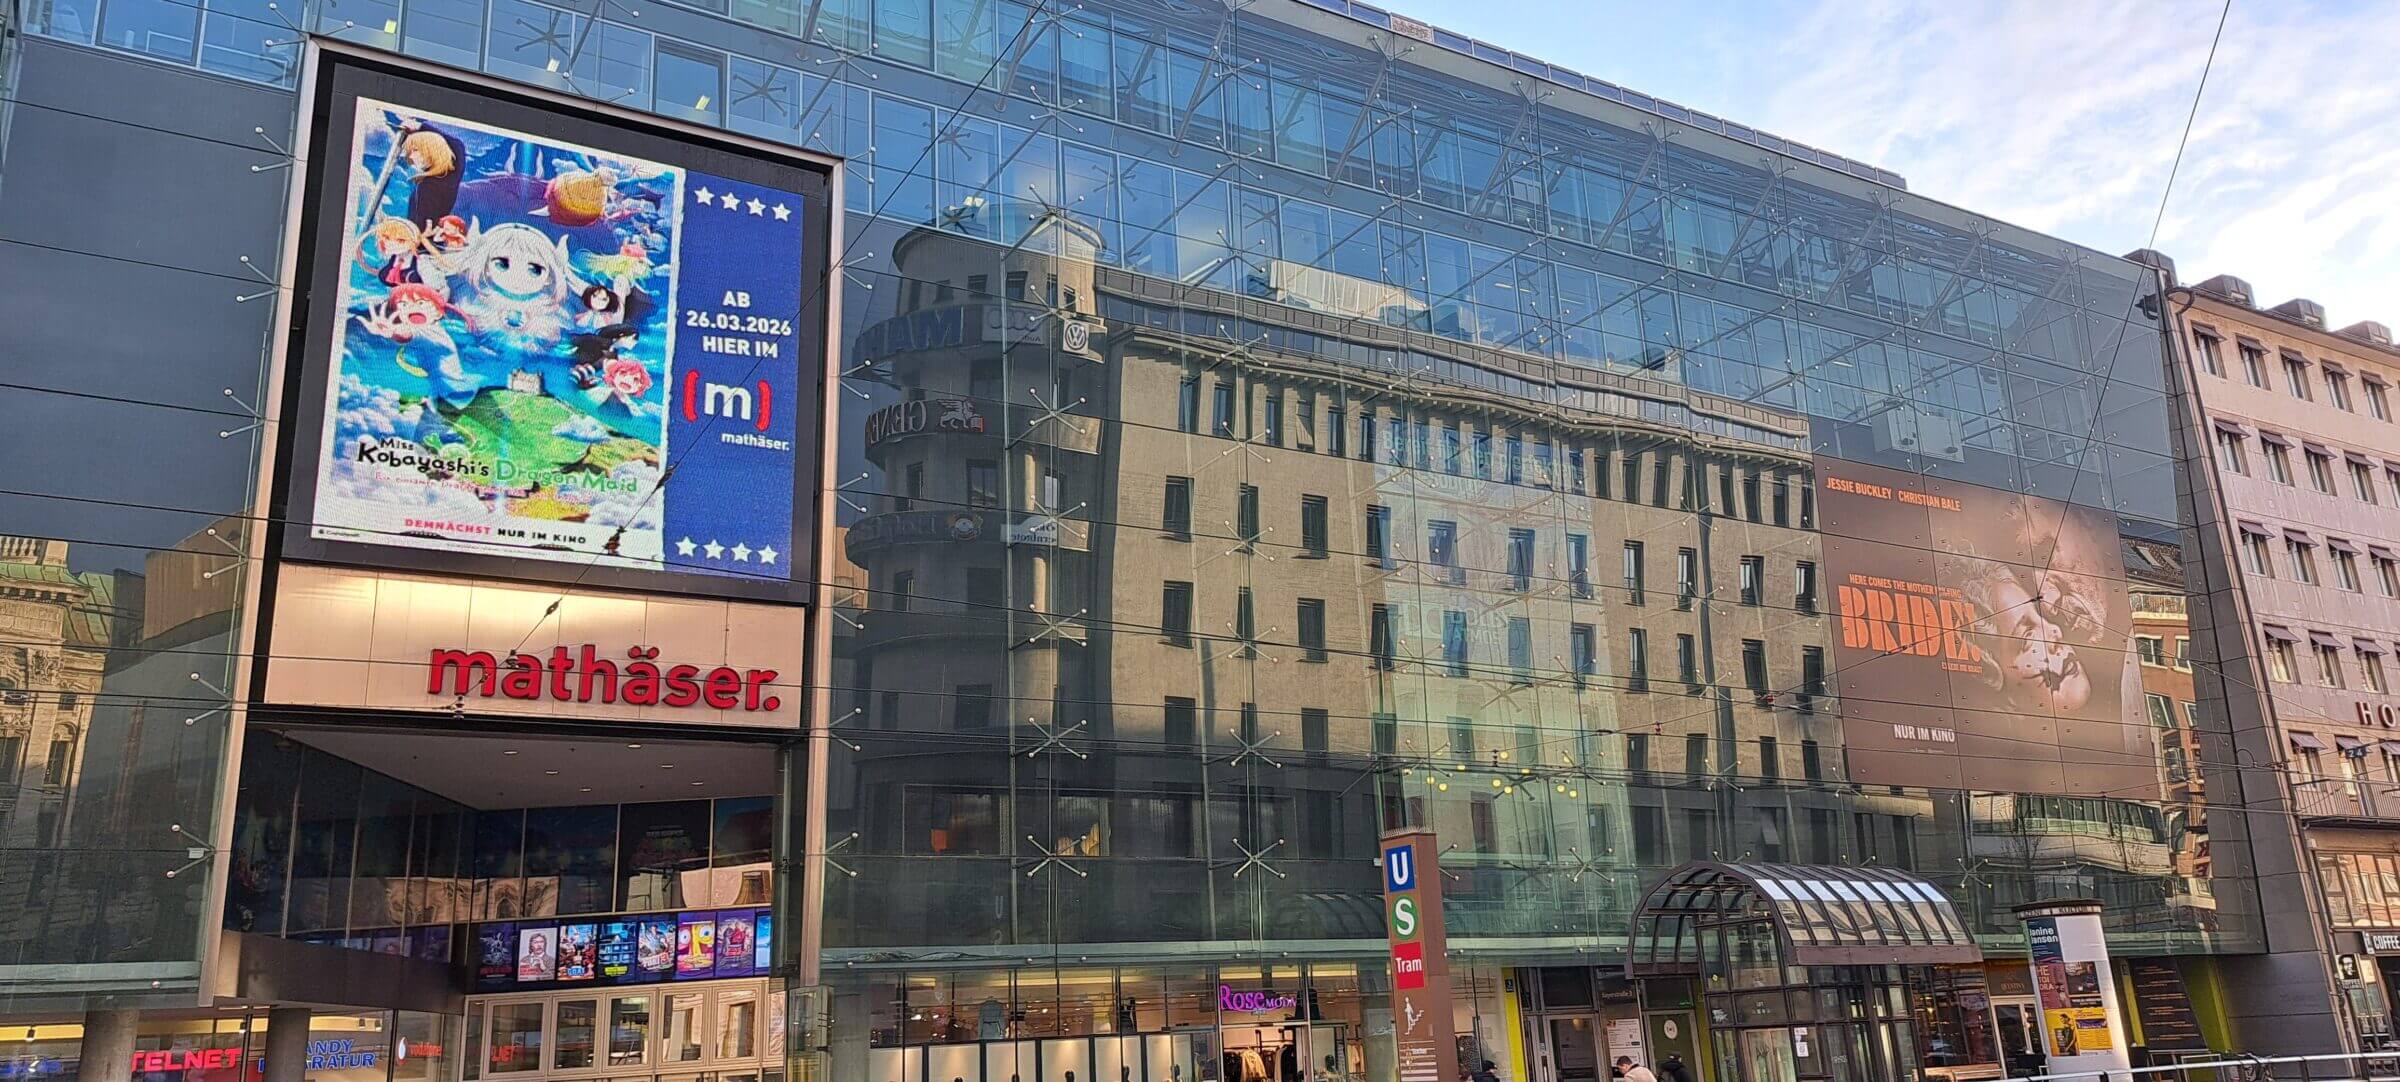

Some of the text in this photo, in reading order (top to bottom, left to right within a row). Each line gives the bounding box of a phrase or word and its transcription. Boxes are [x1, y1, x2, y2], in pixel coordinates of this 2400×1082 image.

[722, 290, 751, 308] AB
[686, 310, 792, 336] 26.03.2026
[702, 335, 779, 358] HIER IM
[381, 437, 414, 450] Miss
[721, 432, 790, 451] mathäser.
[357, 441, 637, 492] Kobayashi's Dragon Maid
[1826, 477, 1961, 512] JESSIE BUCKLEY CHRISTIAN BALE
[405, 517, 587, 544] DEMNÄCHST NUR IM KINO
[1849, 574, 1867, 586] HERE
[1868, 576, 1892, 589] COMES
[1893, 579, 1906, 591] THE
[1906, 582, 1937, 595] MOTHER
[1838, 584, 1981, 662] BRIDE!
[427, 643, 782, 712] mathäser.
[2355, 701, 2400, 728] HO
[1894, 724, 1955, 742] NUR IM KINO
[1391, 851, 1409, 886] U
[1395, 898, 1415, 937] S
[2372, 935, 2400, 950] COFFEE
[1395, 957, 1422, 974] Tram
[1220, 984, 1265, 1011] Rose
[132, 1047, 244, 1073] TELNET
